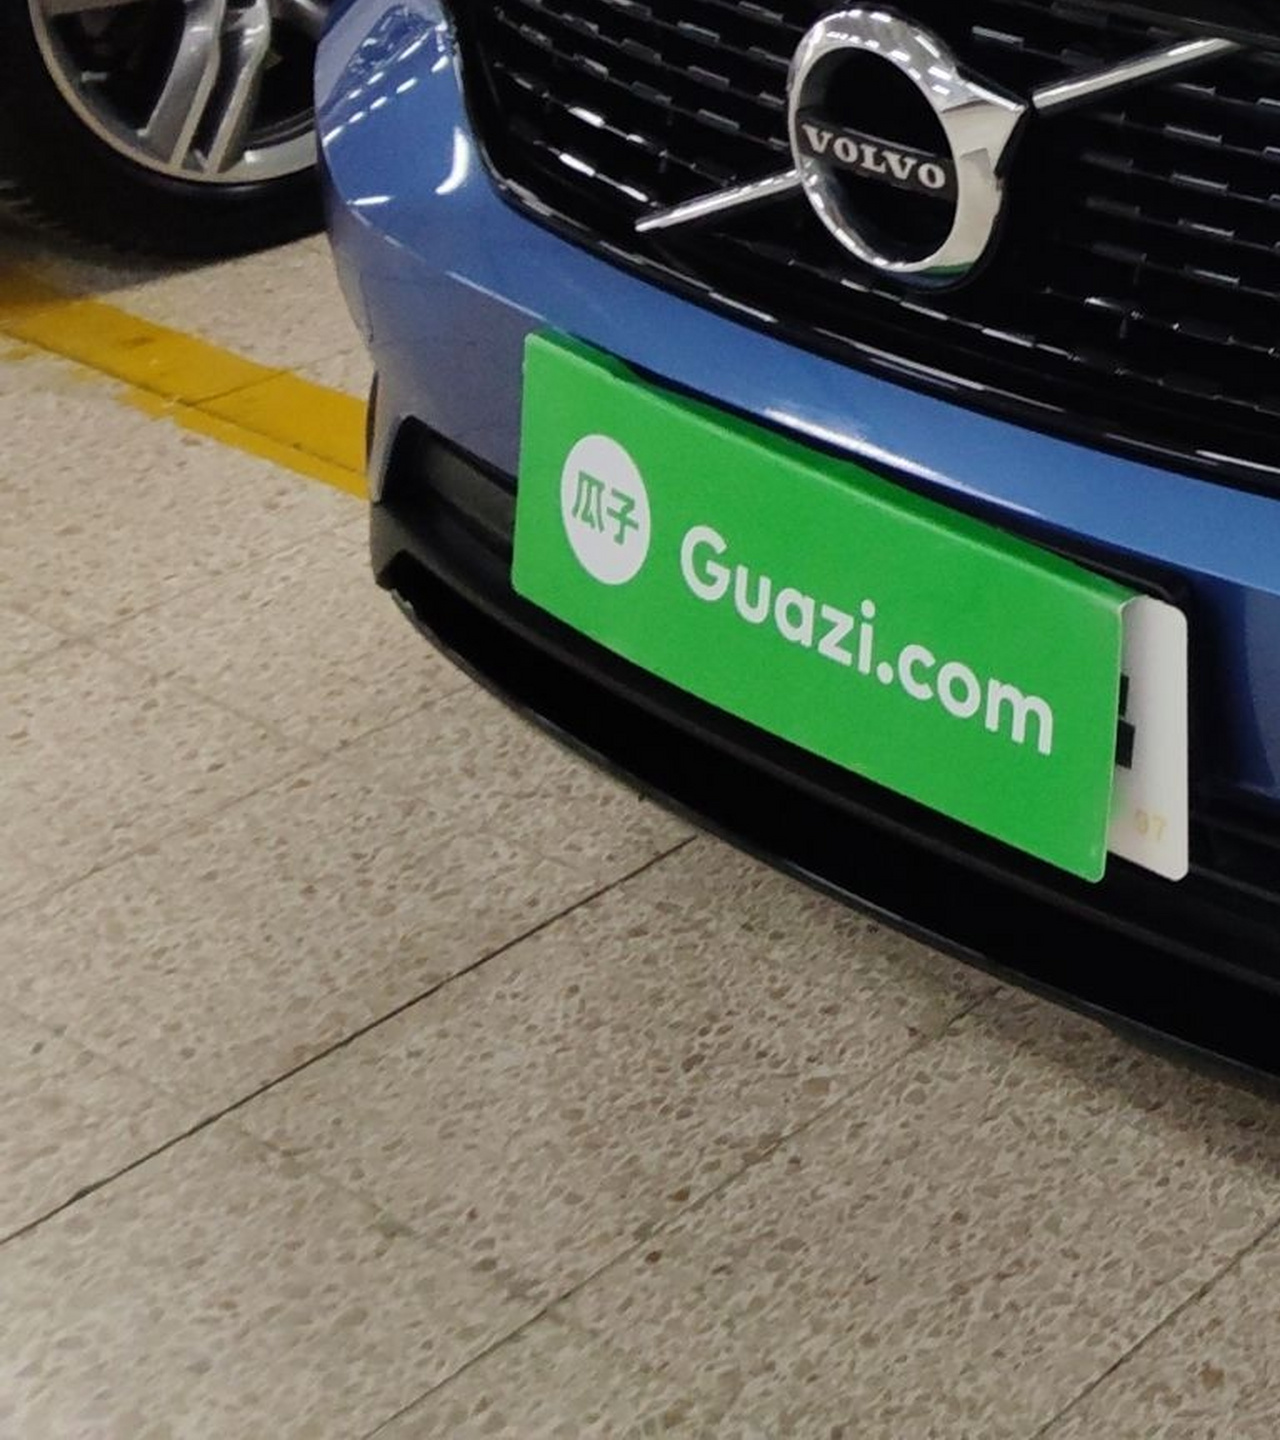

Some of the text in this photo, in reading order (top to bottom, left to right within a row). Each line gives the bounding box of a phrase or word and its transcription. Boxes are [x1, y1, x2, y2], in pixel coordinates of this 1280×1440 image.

[801, 123, 946, 189] VOLVO
[571, 471, 639, 545] 瓜子
[680, 525, 1055, 756] Guazi.com
